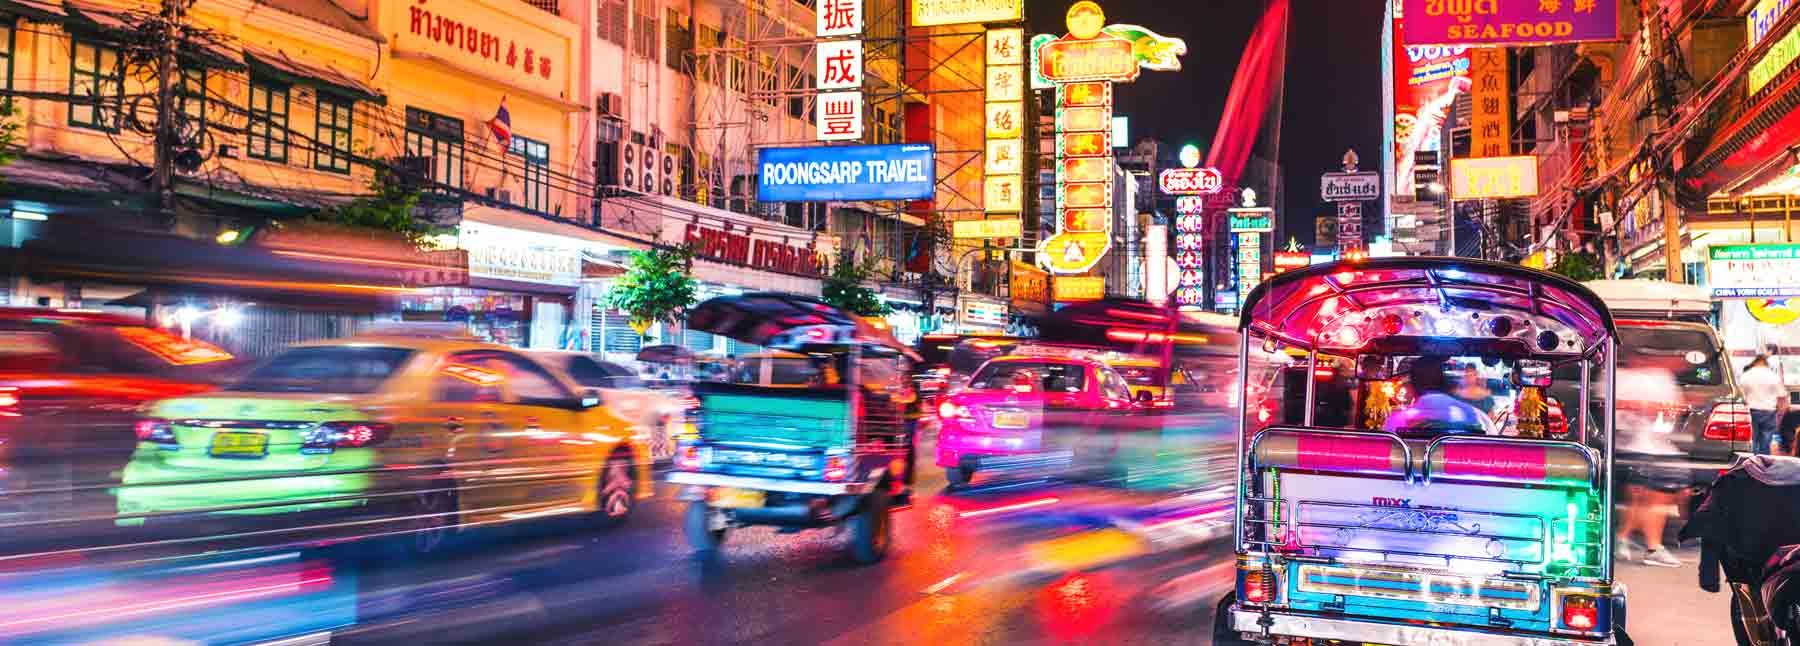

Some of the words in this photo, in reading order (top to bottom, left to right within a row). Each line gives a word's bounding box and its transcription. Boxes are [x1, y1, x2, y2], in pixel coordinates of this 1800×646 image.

[1448, 21, 1574, 40] SEAFOOD
[763, 161, 863, 185] ROONGSARP
[866, 159, 928, 183] TRAVEL
